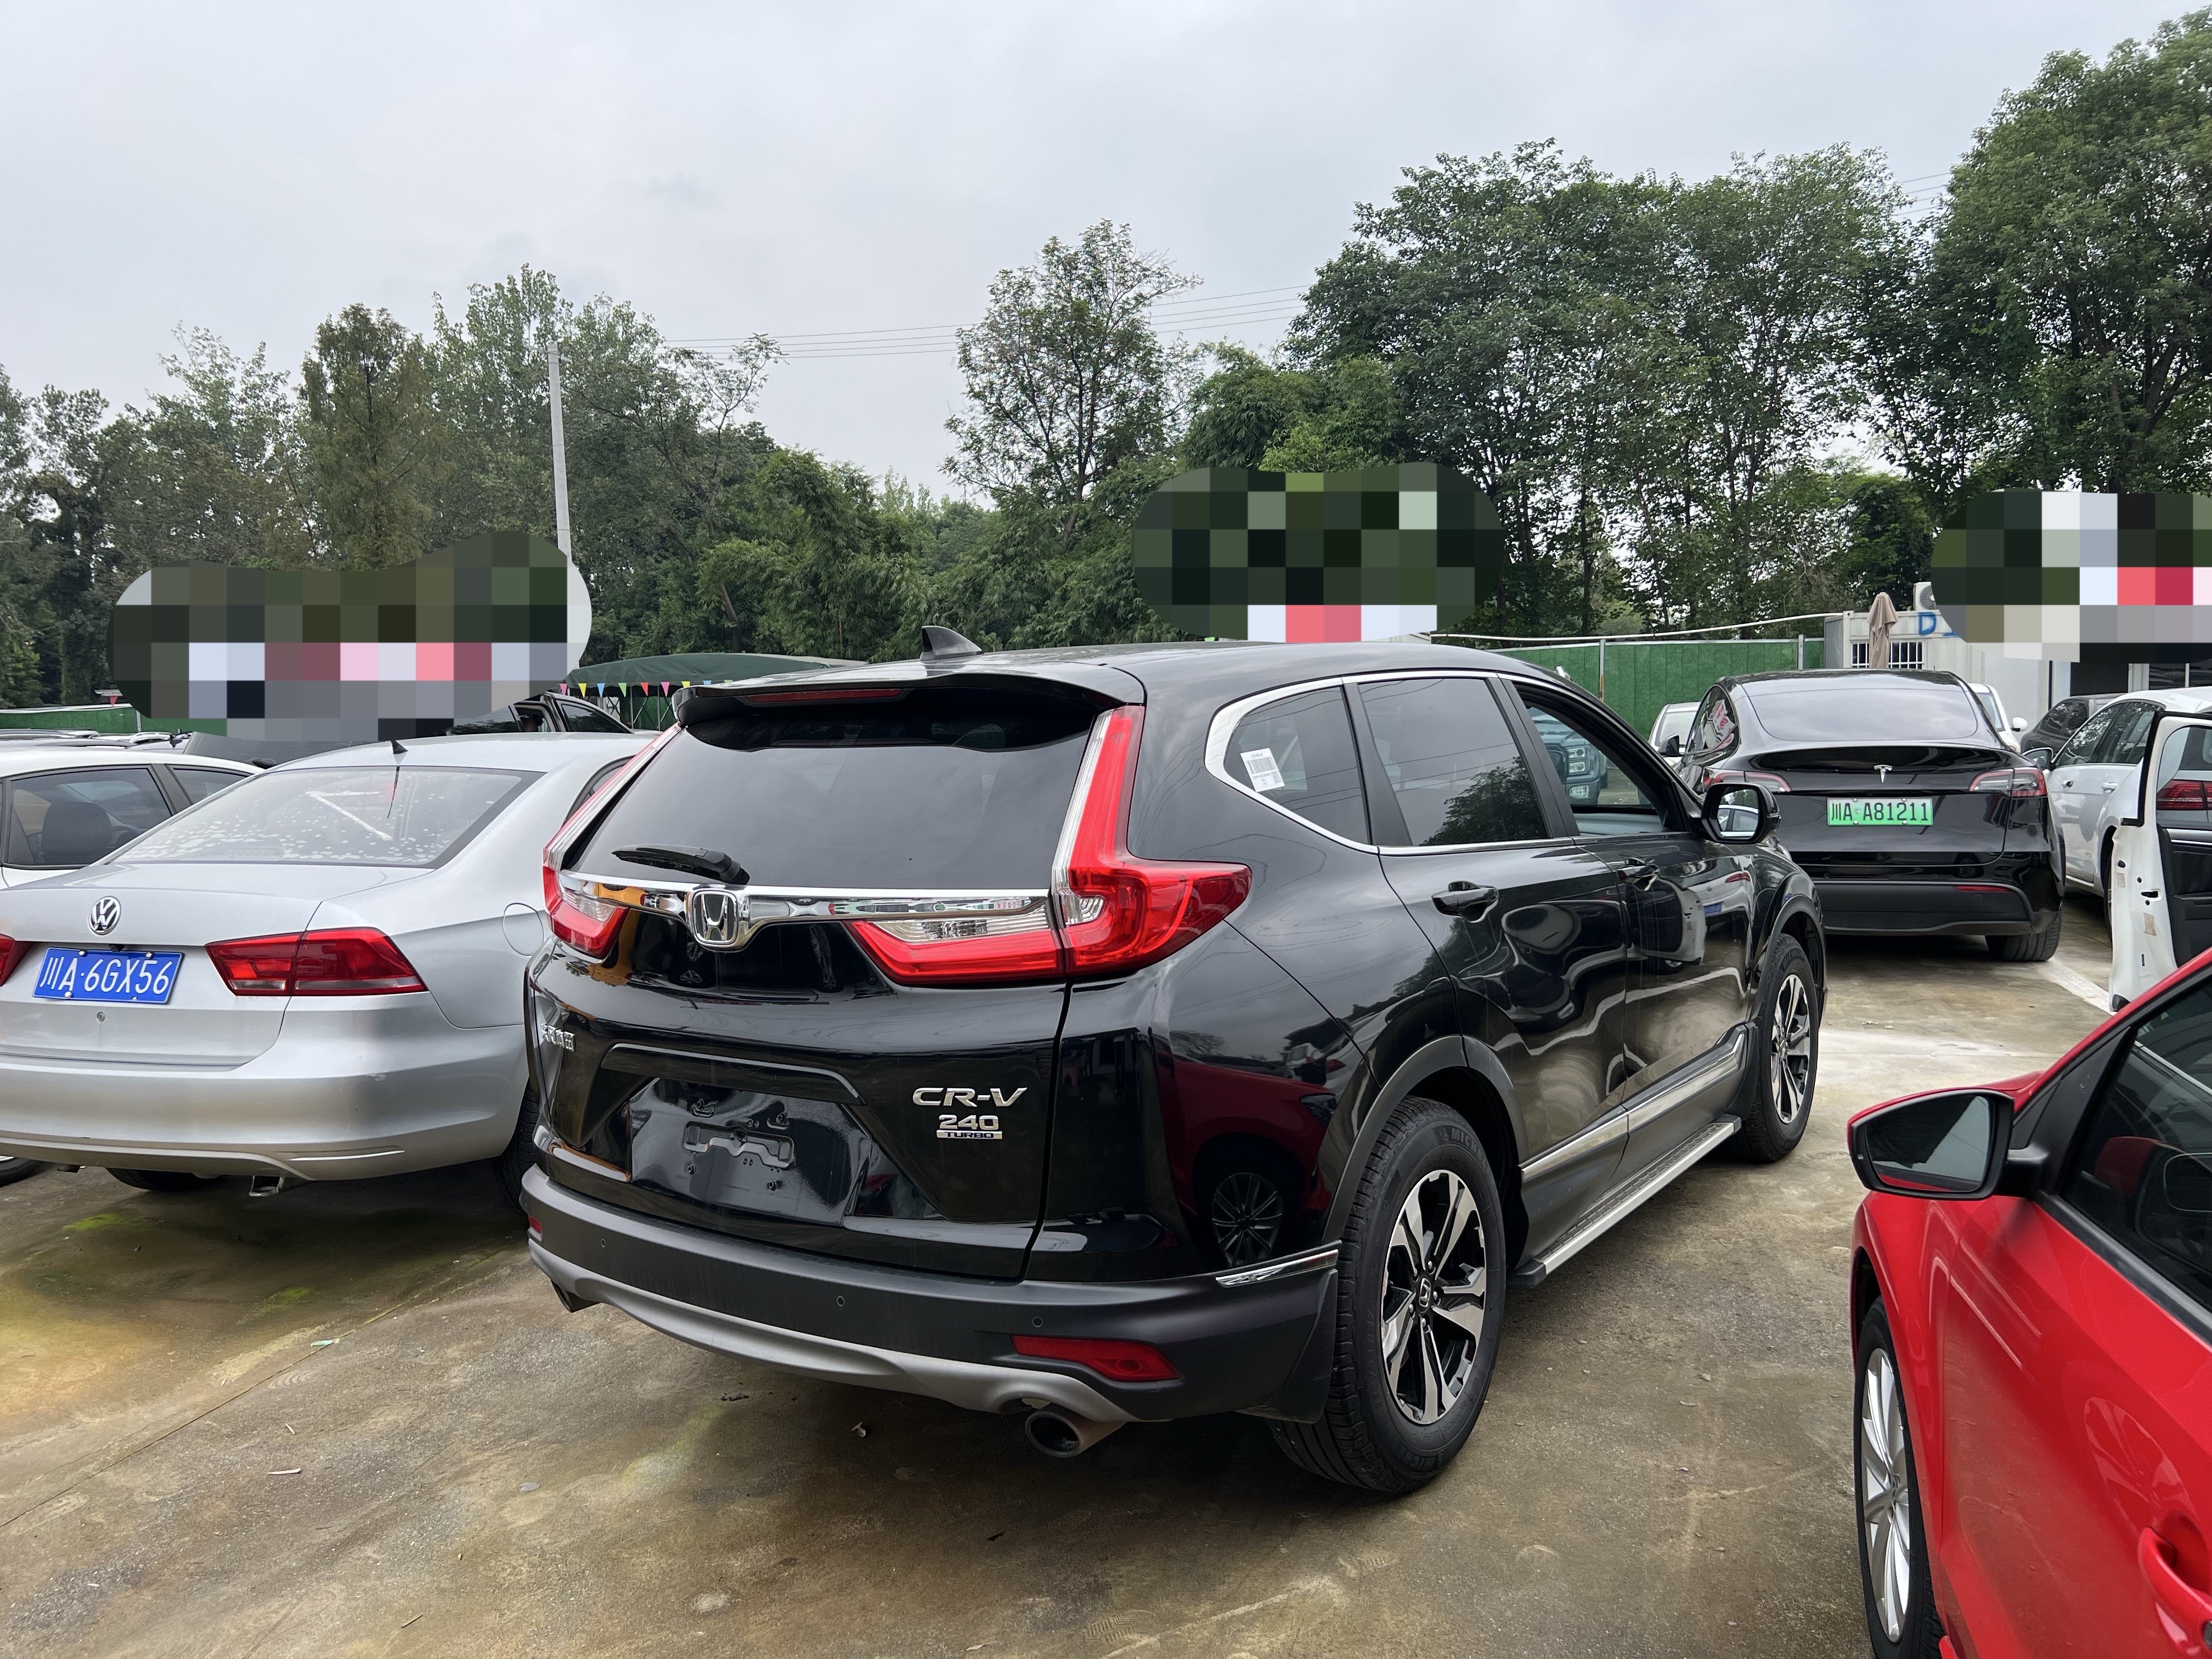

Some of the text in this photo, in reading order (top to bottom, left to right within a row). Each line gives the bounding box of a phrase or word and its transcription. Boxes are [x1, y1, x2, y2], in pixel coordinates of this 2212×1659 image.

[1863, 802, 1928, 821] A81211
[912, 1087, 1027, 1107] CR-V
[939, 1114, 999, 1131] 240
